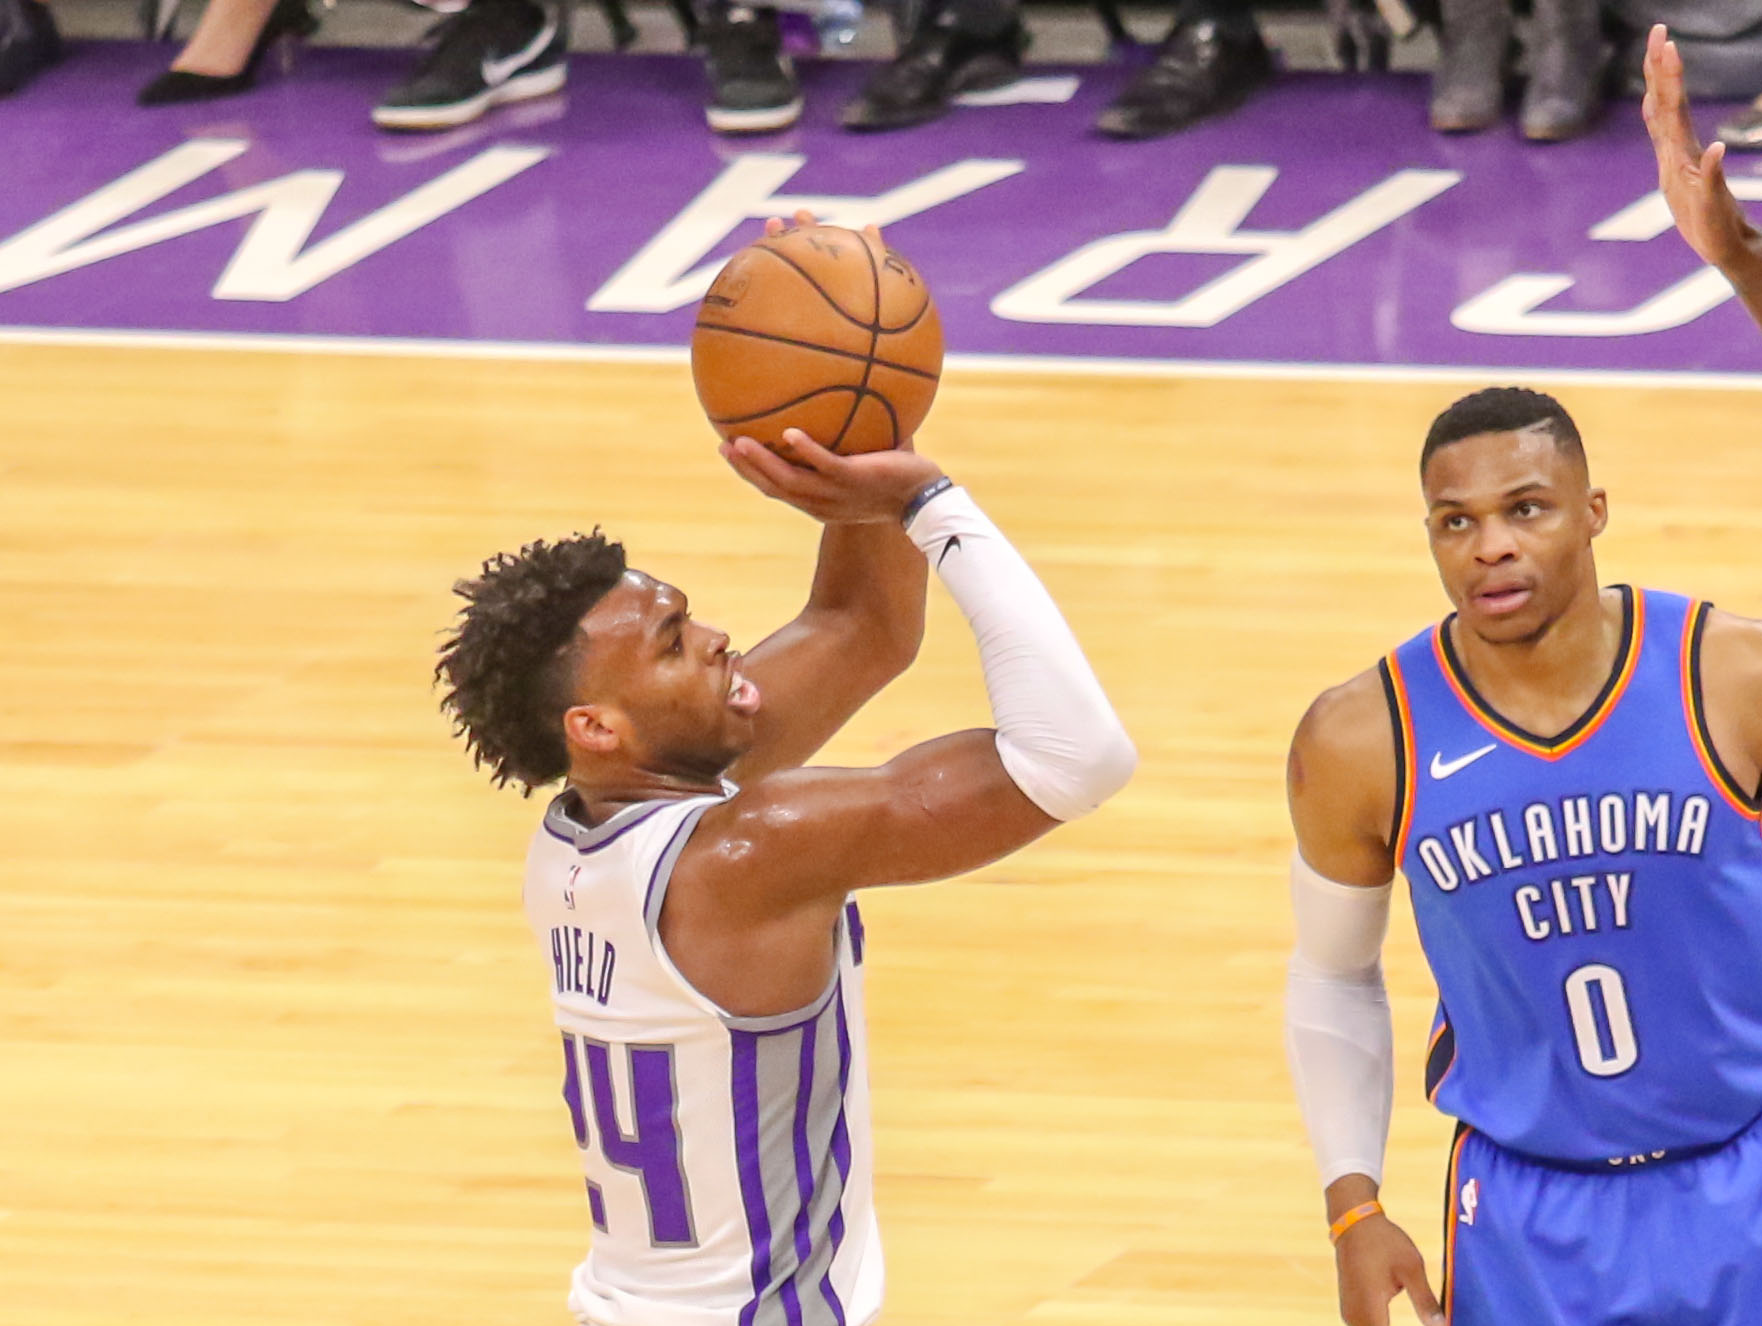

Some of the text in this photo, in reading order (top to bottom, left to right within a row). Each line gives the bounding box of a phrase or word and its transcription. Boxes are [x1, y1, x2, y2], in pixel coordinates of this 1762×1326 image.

[1416, 792, 1711, 893] OKLAHOMA
[1514, 871, 1632, 941] CITY
[551, 925, 616, 1006] HIELD
[1565, 961, 1640, 1078] 0
